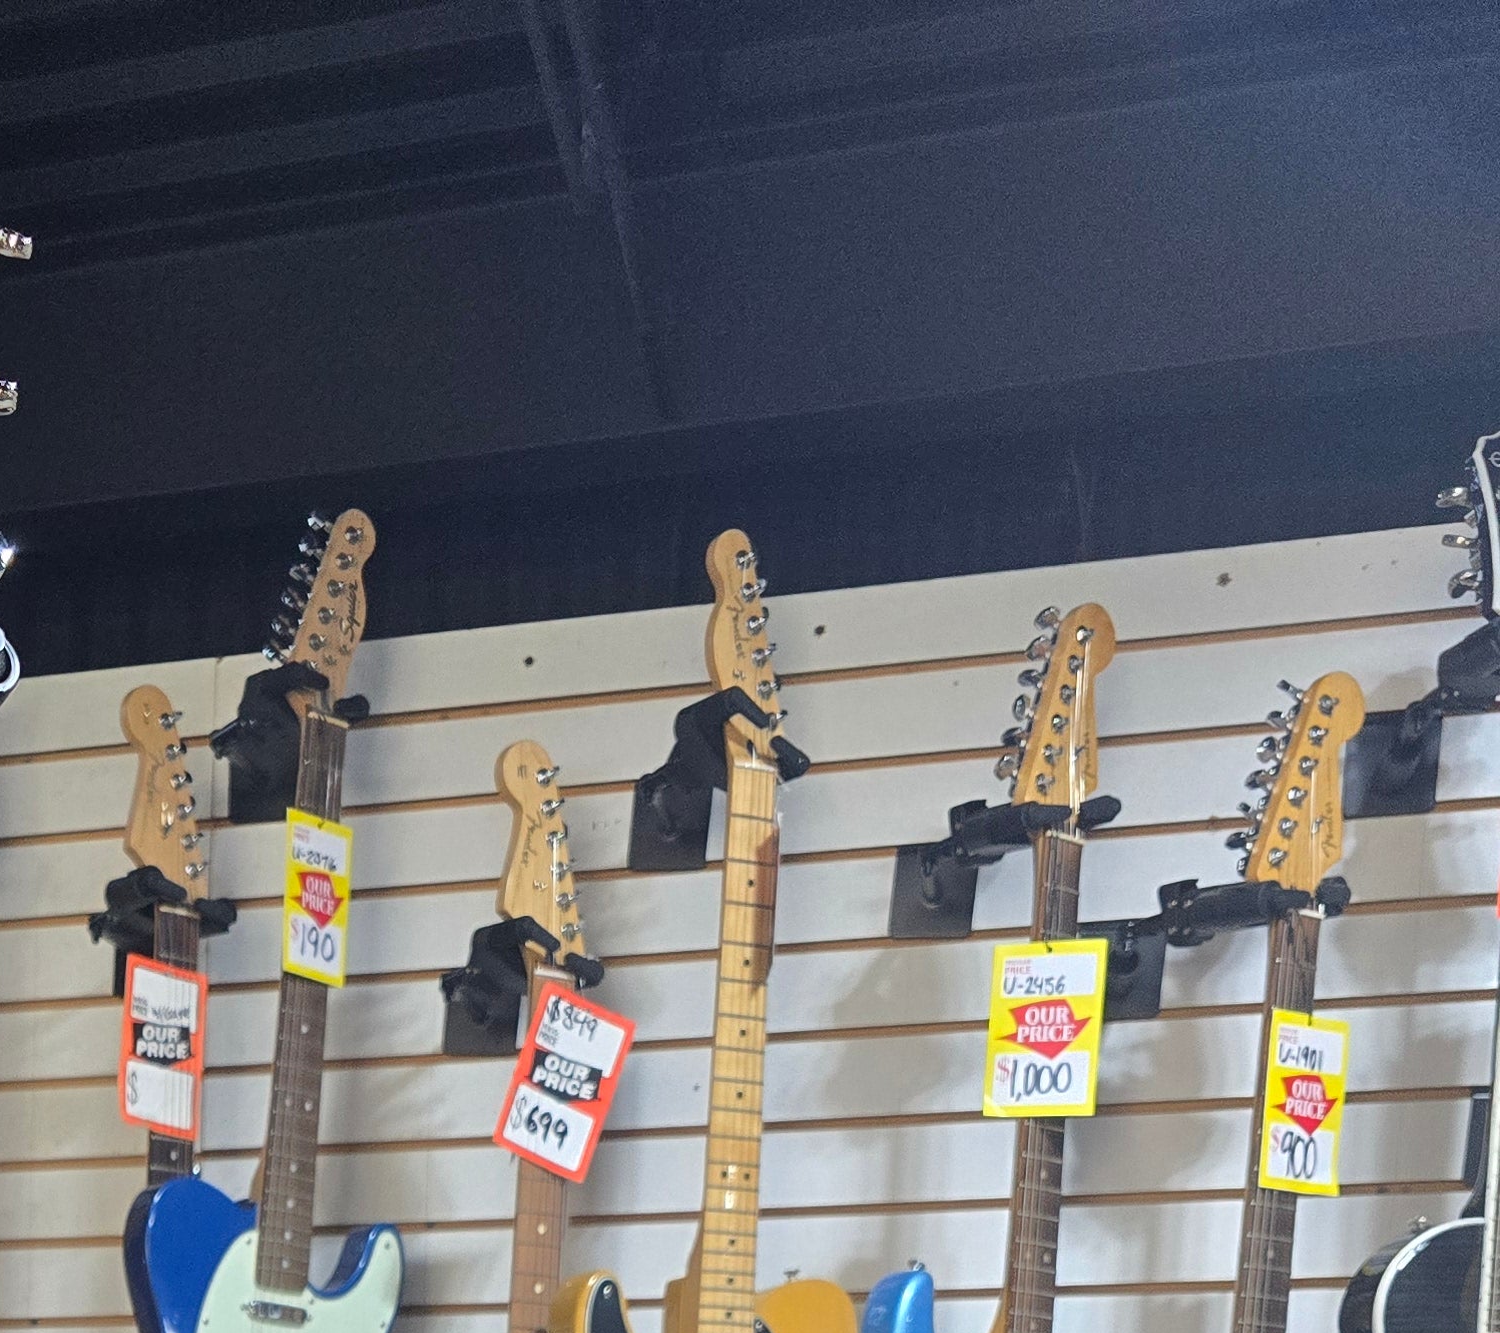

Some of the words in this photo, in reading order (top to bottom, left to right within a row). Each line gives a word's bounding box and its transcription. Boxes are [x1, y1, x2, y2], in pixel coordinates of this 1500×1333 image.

[726, 595, 751, 660] Fender
[520, 811, 542, 868] Fender
[305, 874, 332, 897] OUR
[301, 892, 335, 917] PRICE
[1003, 975, 1066, 996] U-2456
[1025, 1005, 1070, 1026] OUR
[141, 1024, 181, 1043] OUR
[1016, 1024, 1076, 1043] PRICE
[136, 1040, 190, 1060] PRICE
[543, 1055, 592, 1080] OUR
[531, 1069, 598, 1101] PRICE
[996, 1058, 1073, 1103] $1,000
[1291, 1078, 1324, 1100] OUR
[1284, 1099, 1327, 1121] PRICE
[509, 1096, 569, 1150] $699
